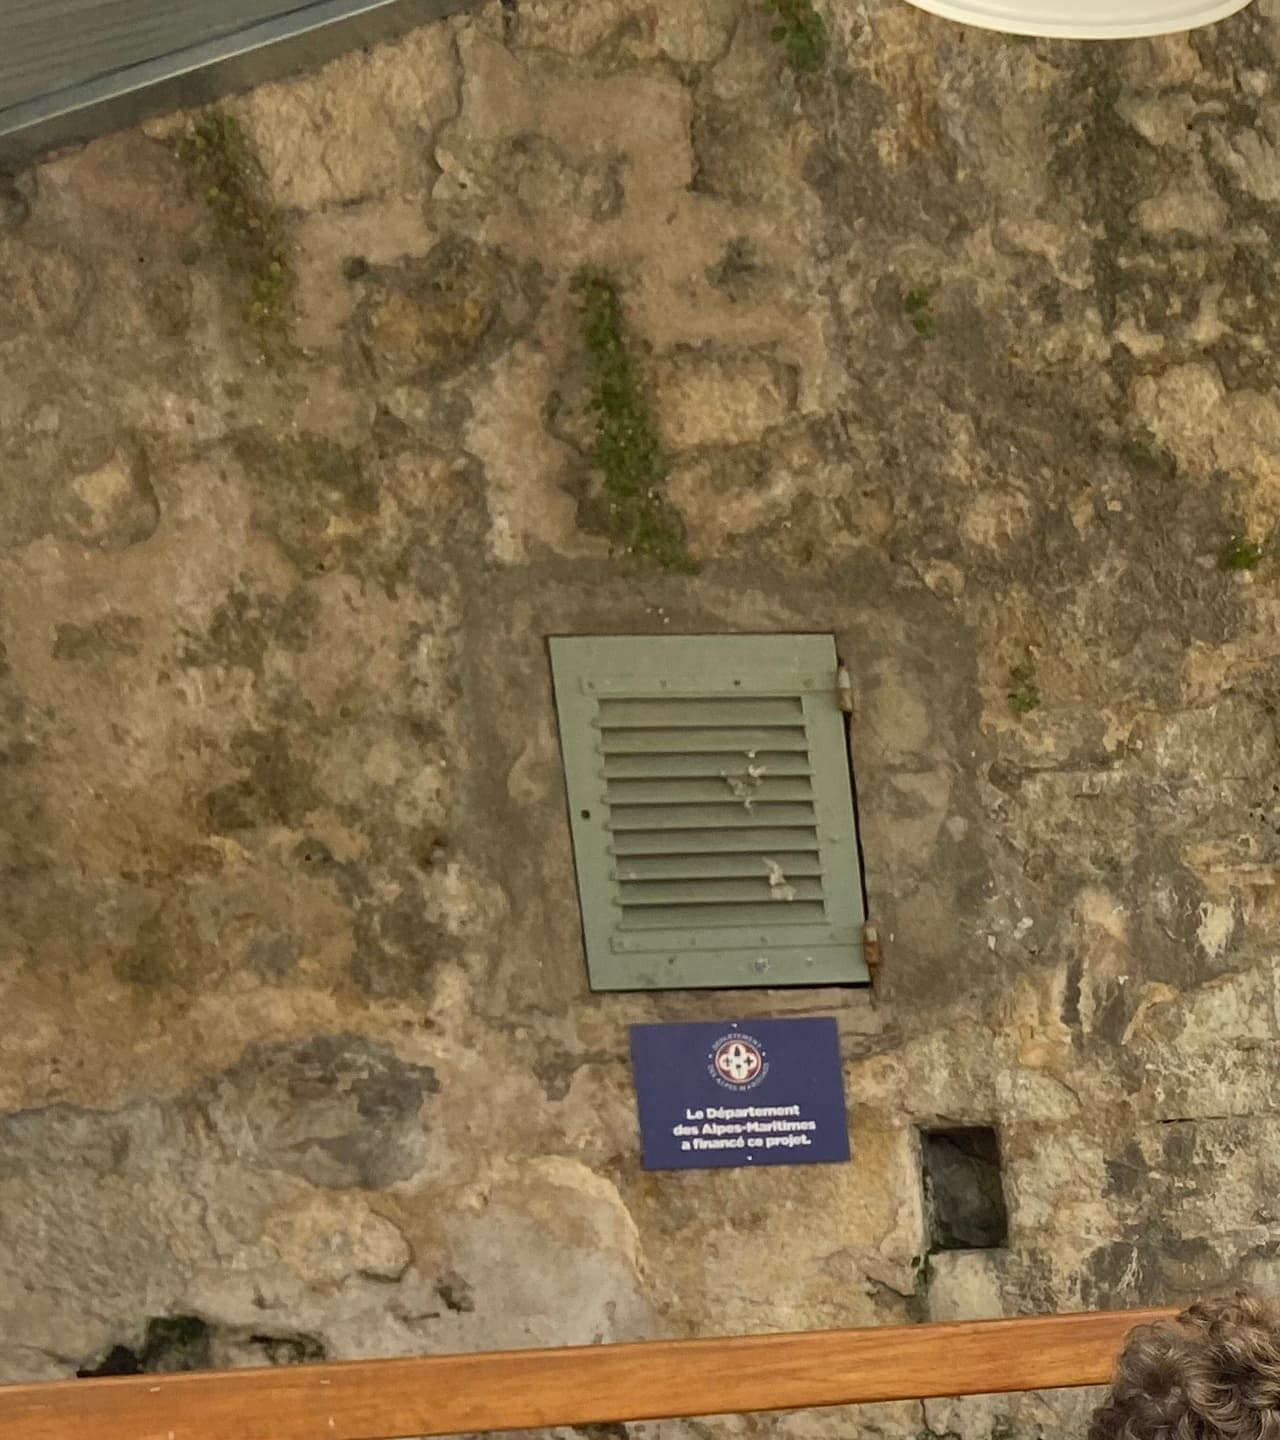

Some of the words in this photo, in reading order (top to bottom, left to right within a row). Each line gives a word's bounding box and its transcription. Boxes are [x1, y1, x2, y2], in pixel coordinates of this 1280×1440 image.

[686, 1108, 704, 1120] Le
[706, 1105, 800, 1120] Département
[673, 1123, 699, 1136] des
[702, 1120, 816, 1136] Alpes-Maritimes
[681, 1140, 691, 1151] a
[693, 1135, 745, 1150] financé
[747, 1137, 763, 1148] ce
[765, 1134, 812, 1149] projet.
